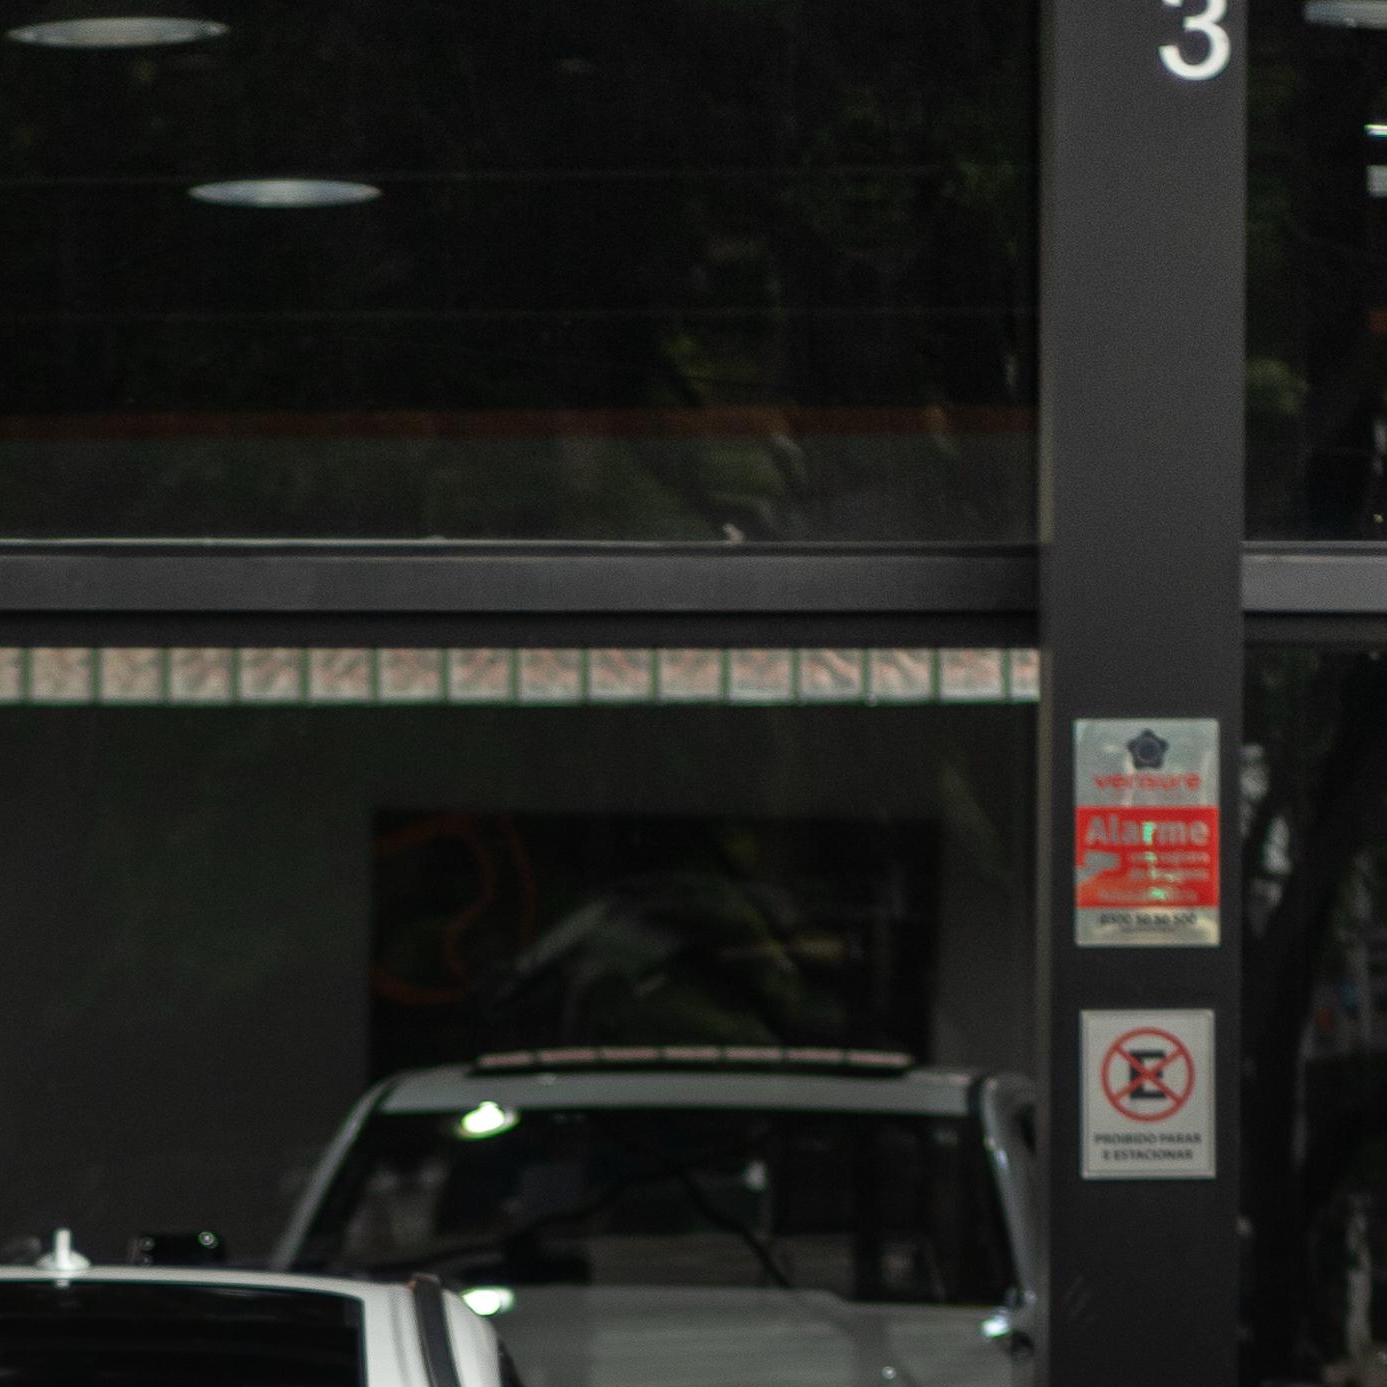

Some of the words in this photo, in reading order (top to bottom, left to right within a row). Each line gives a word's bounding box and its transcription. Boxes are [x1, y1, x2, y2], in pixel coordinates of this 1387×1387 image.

[1158, 0, 1231, 81] 3
[1086, 815, 1208, 845] Alarme
[1094, 1133, 1157, 1146] PROIBIDO
[1160, 1133, 1202, 1145] PARAR
[1114, 1150, 1194, 1161] ESTACIONAR
